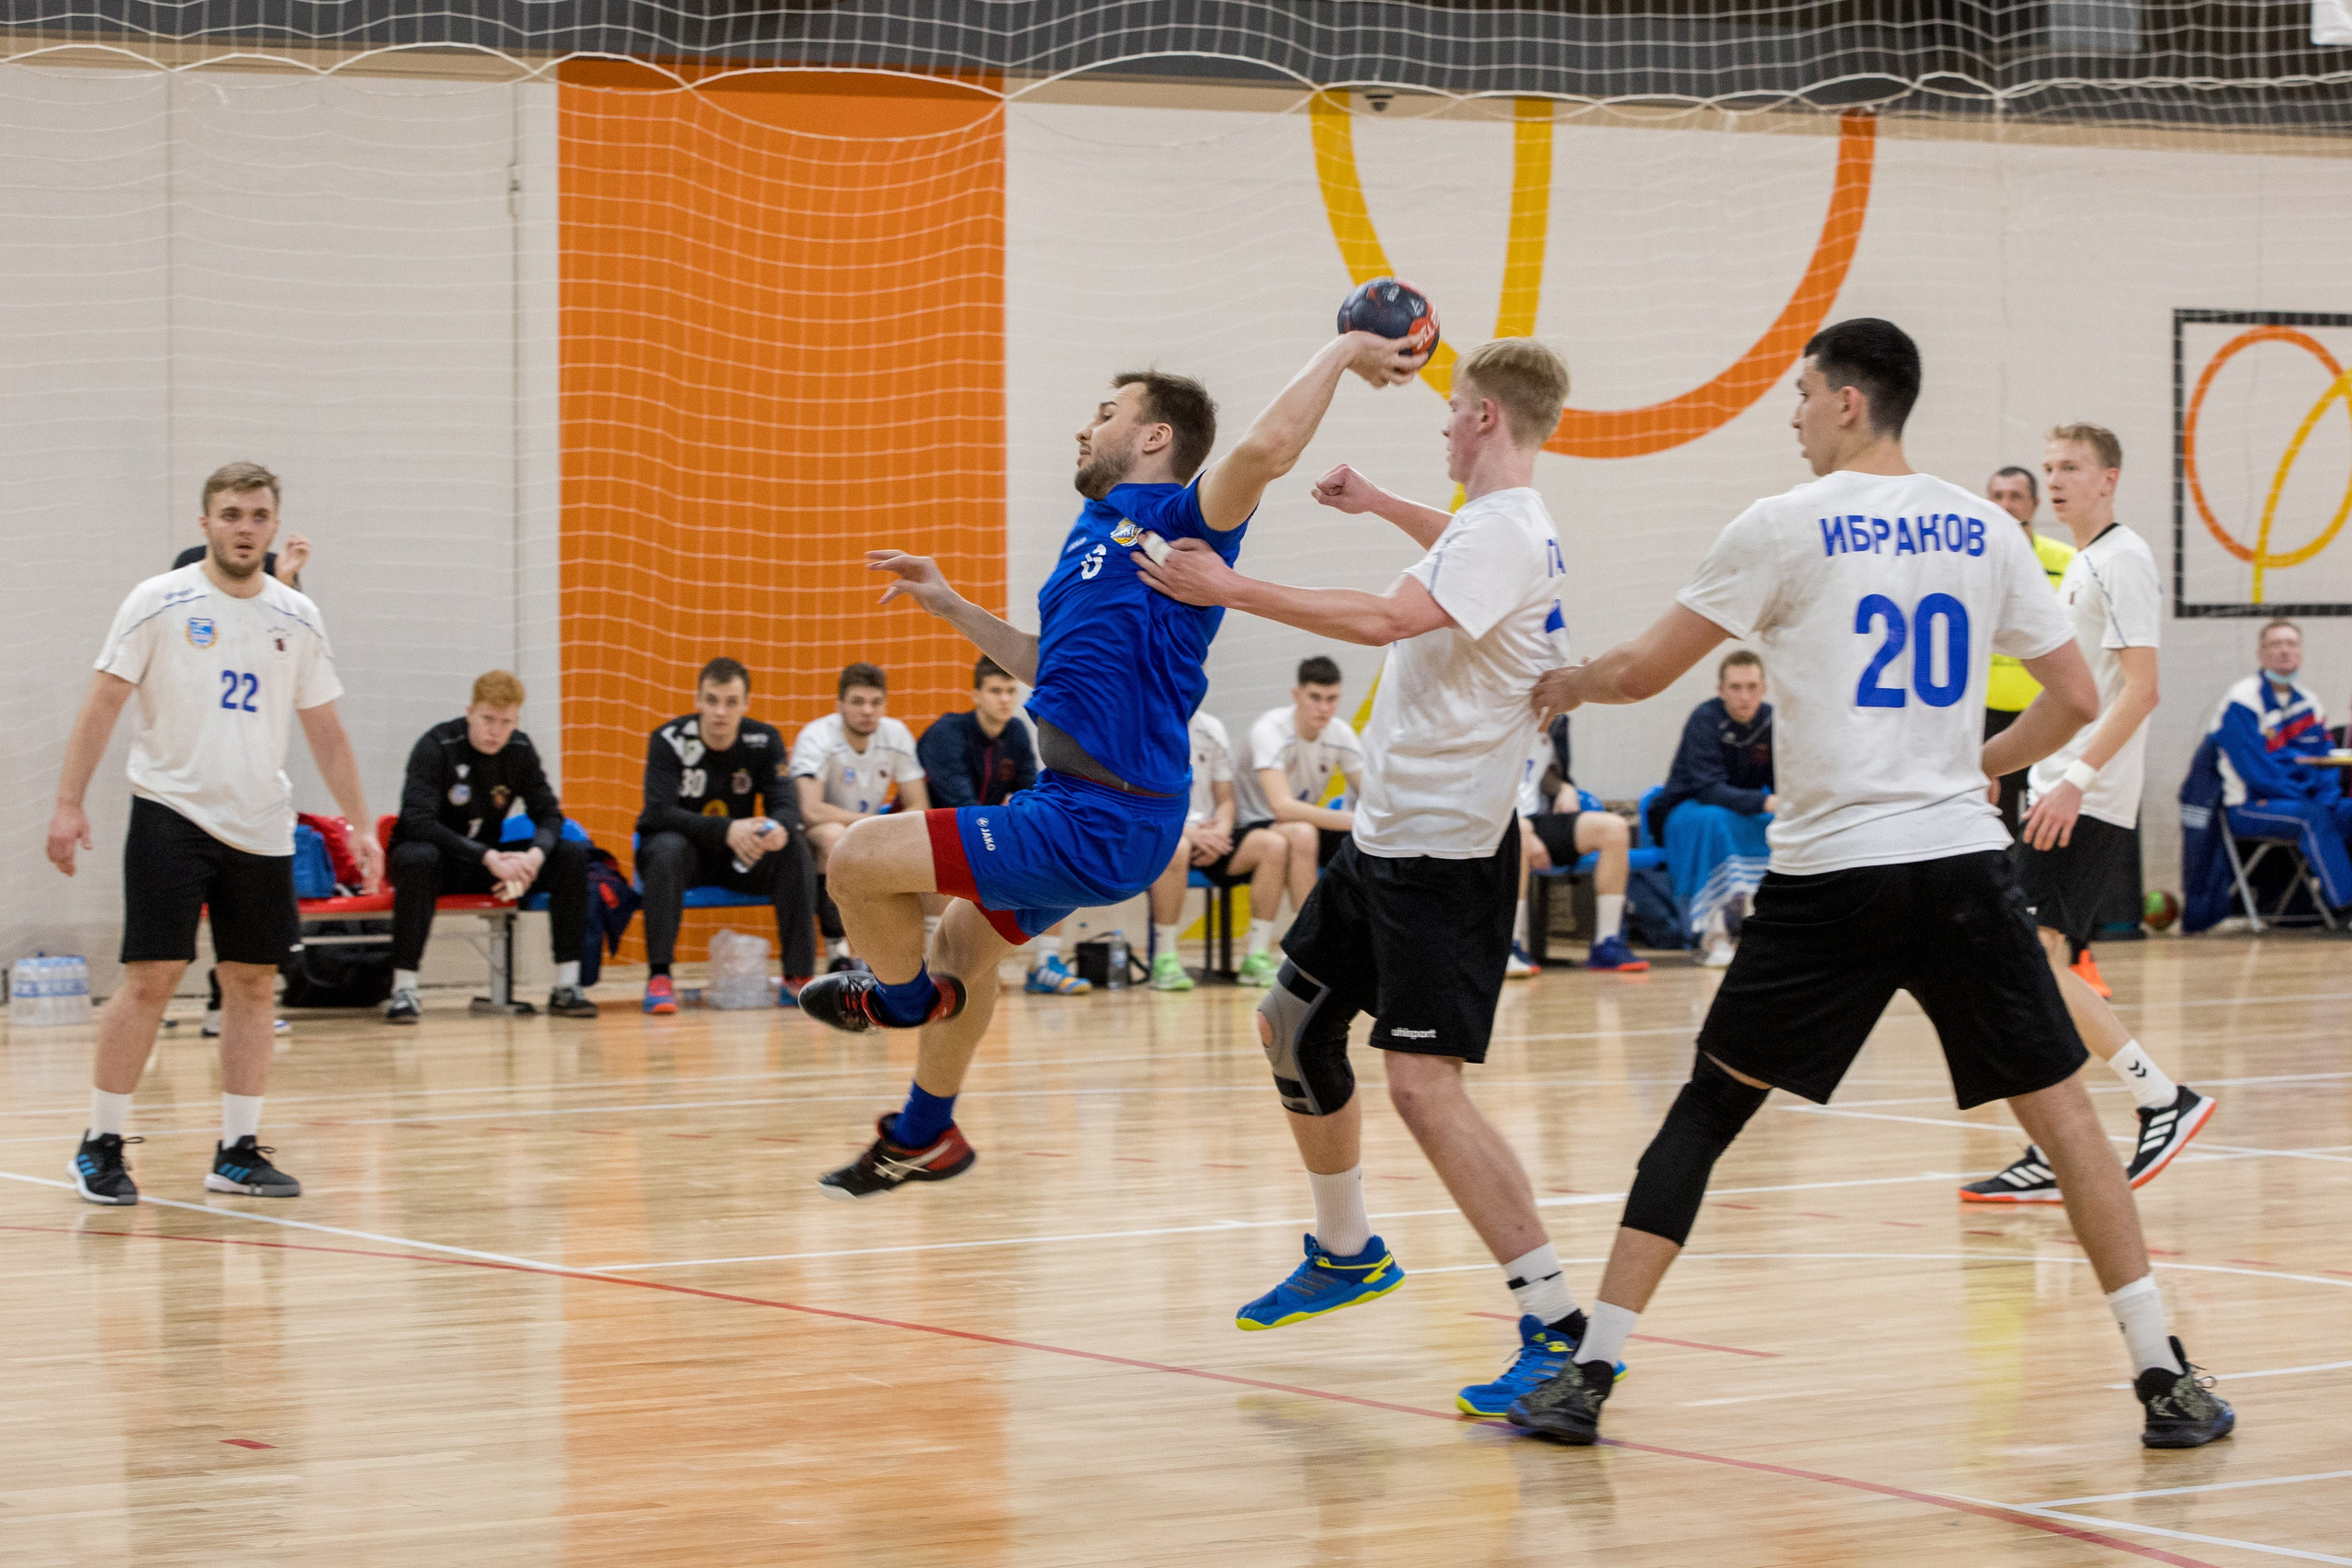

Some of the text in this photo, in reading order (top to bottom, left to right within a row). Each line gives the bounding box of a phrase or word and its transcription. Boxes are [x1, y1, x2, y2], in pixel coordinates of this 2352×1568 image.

[1820, 513, 1985, 557] ИБРАКОВ
[1854, 592, 1969, 707] 20
[221, 670, 258, 713] 22
[679, 768, 707, 798] 30
[980, 828, 996, 852] JAKO
